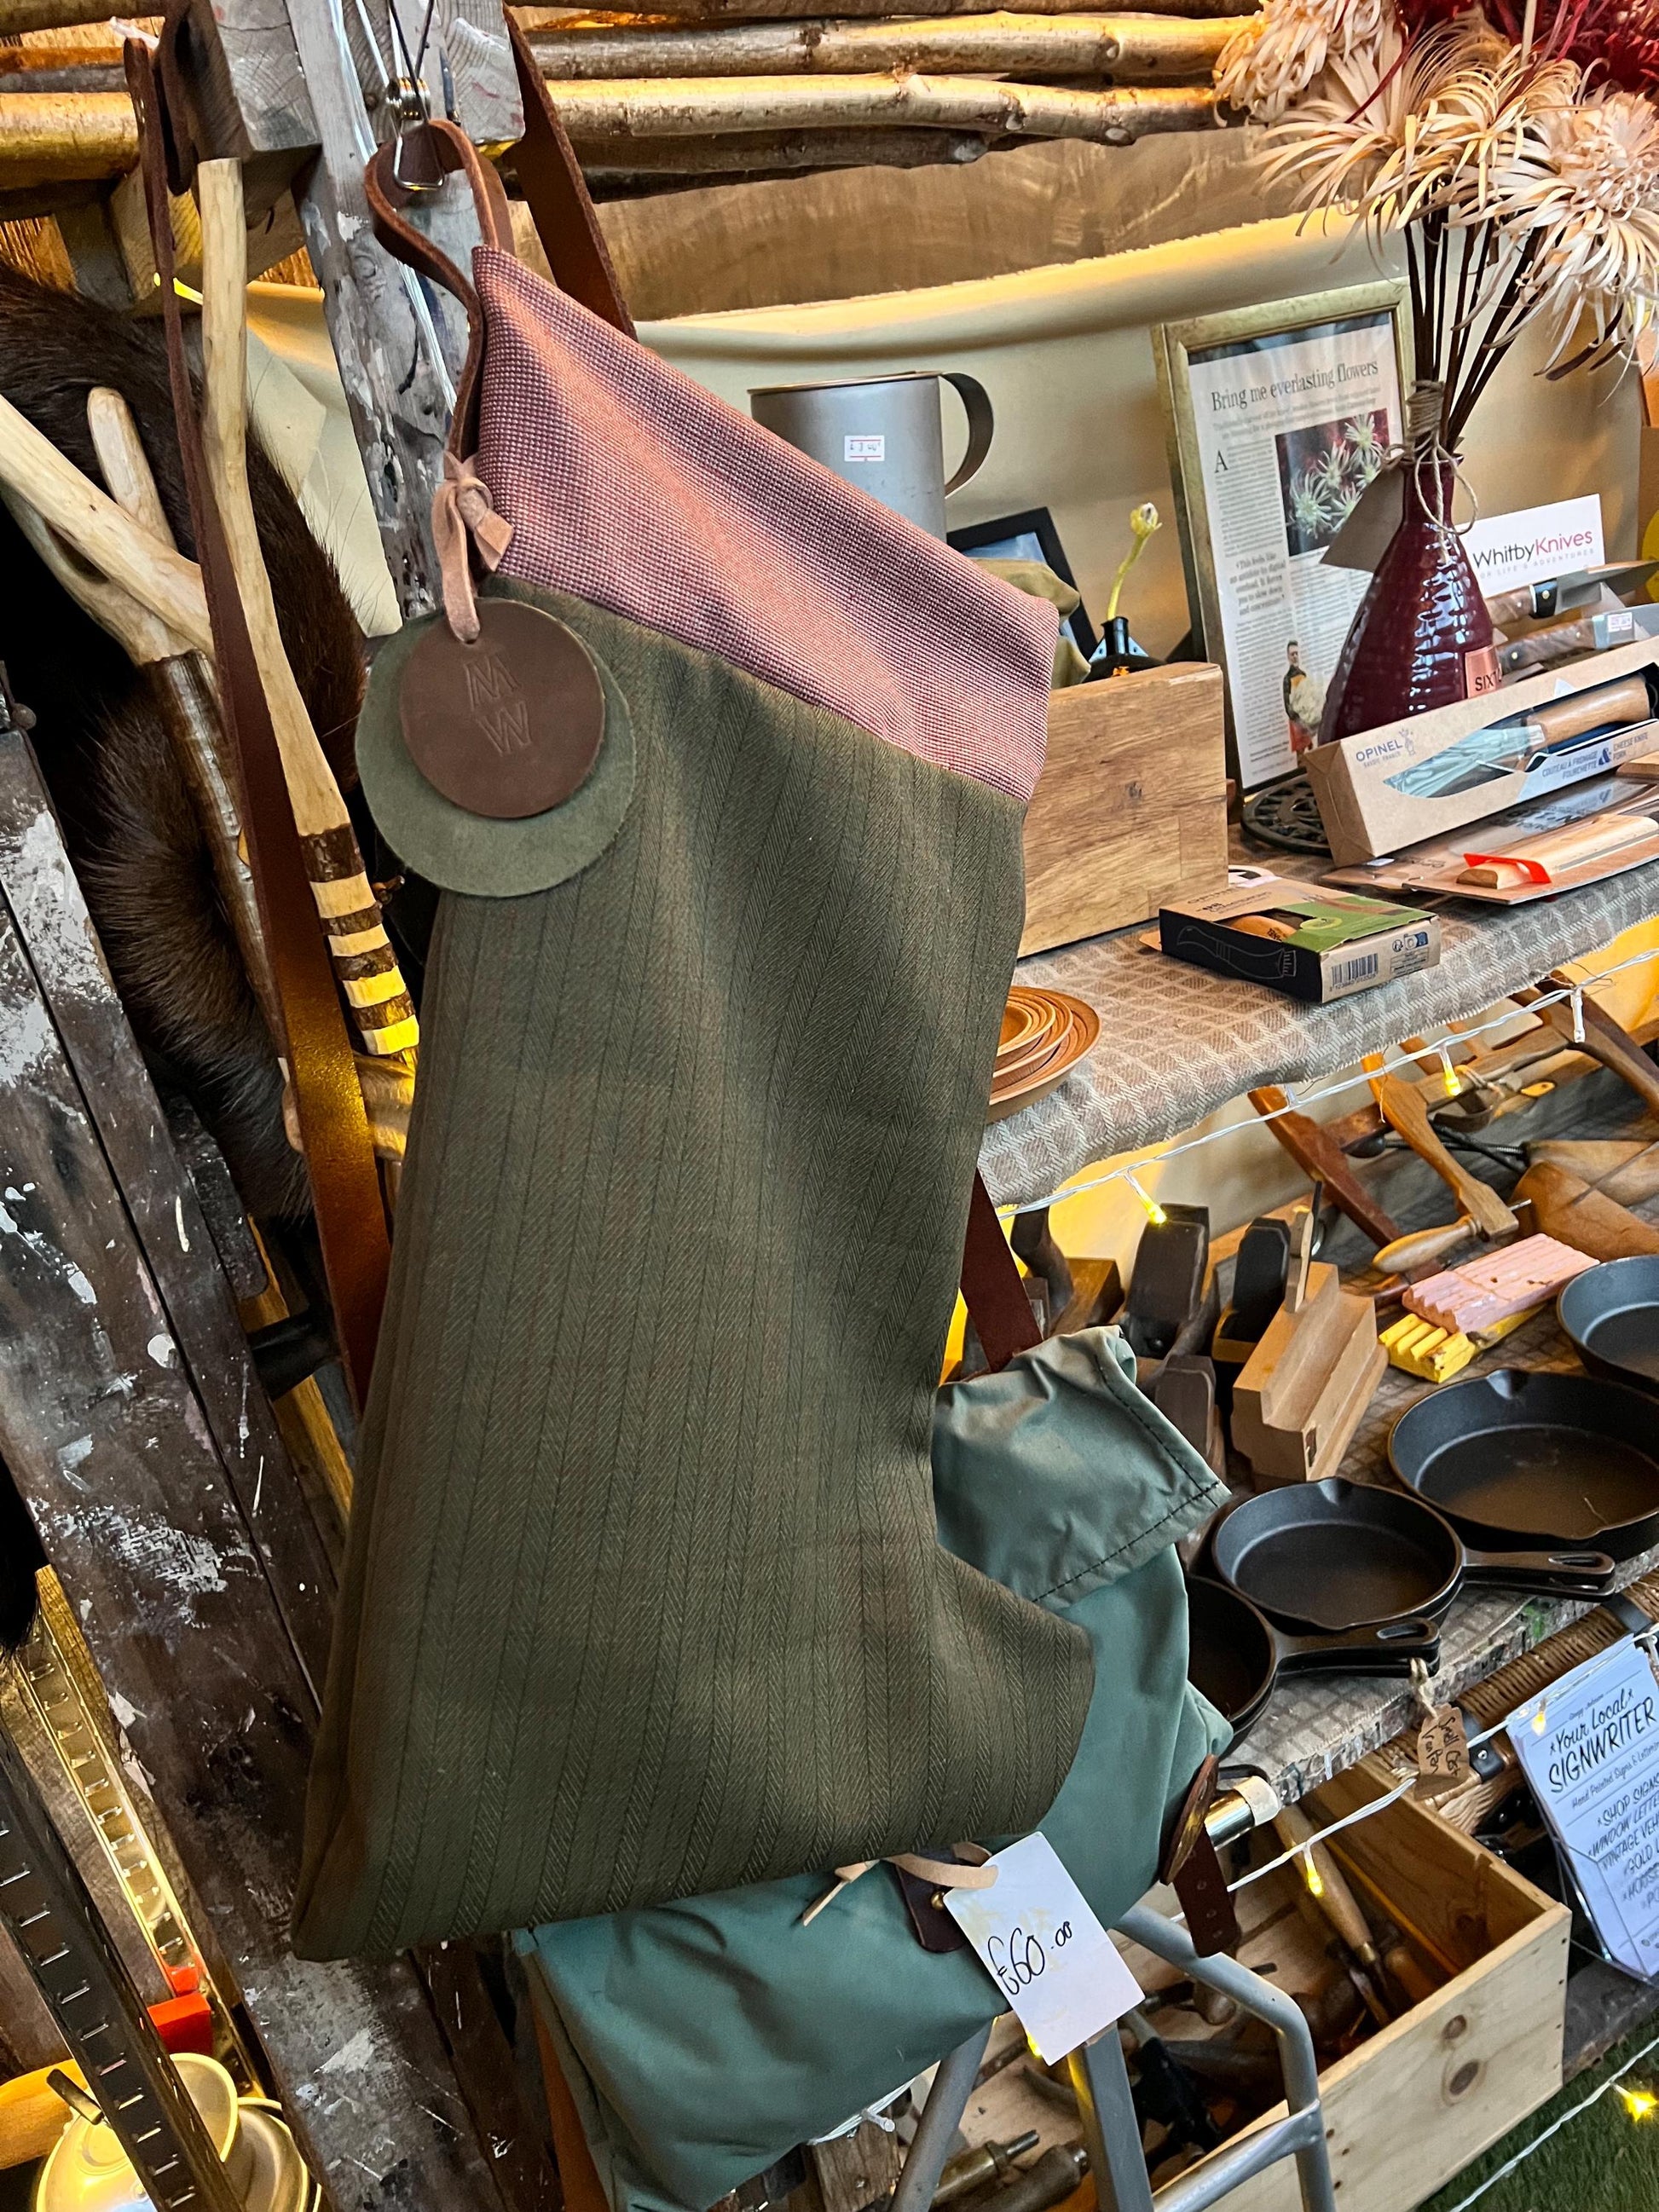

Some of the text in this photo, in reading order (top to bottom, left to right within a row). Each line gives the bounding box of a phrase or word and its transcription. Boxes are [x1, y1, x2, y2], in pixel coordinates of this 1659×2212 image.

[1211, 361, 1379, 411] Bring me everlasting flowers
[1214, 449, 1228, 474] A
[1472, 531, 1593, 569] WhitbyKnives
[1356, 738, 1404, 763] OPINEL
[1438, 1716, 1460, 1747] Small
[1556, 1724, 1589, 1754] Your
[1592, 1688, 1627, 1730] Local
[1549, 1695, 1657, 1793] SIGNWRITER
[1572, 1788, 1590, 1809] Hand
[1614, 1762, 1633, 1780] Signs
[1603, 1794, 1631, 1827] SHOP
[1593, 1813, 1632, 1857] WINDOW
[1602, 1828, 1640, 1871] VINTAGE
[1627, 1844, 1653, 1874] GOLD
[987, 1920, 1072, 1995] £60.00
